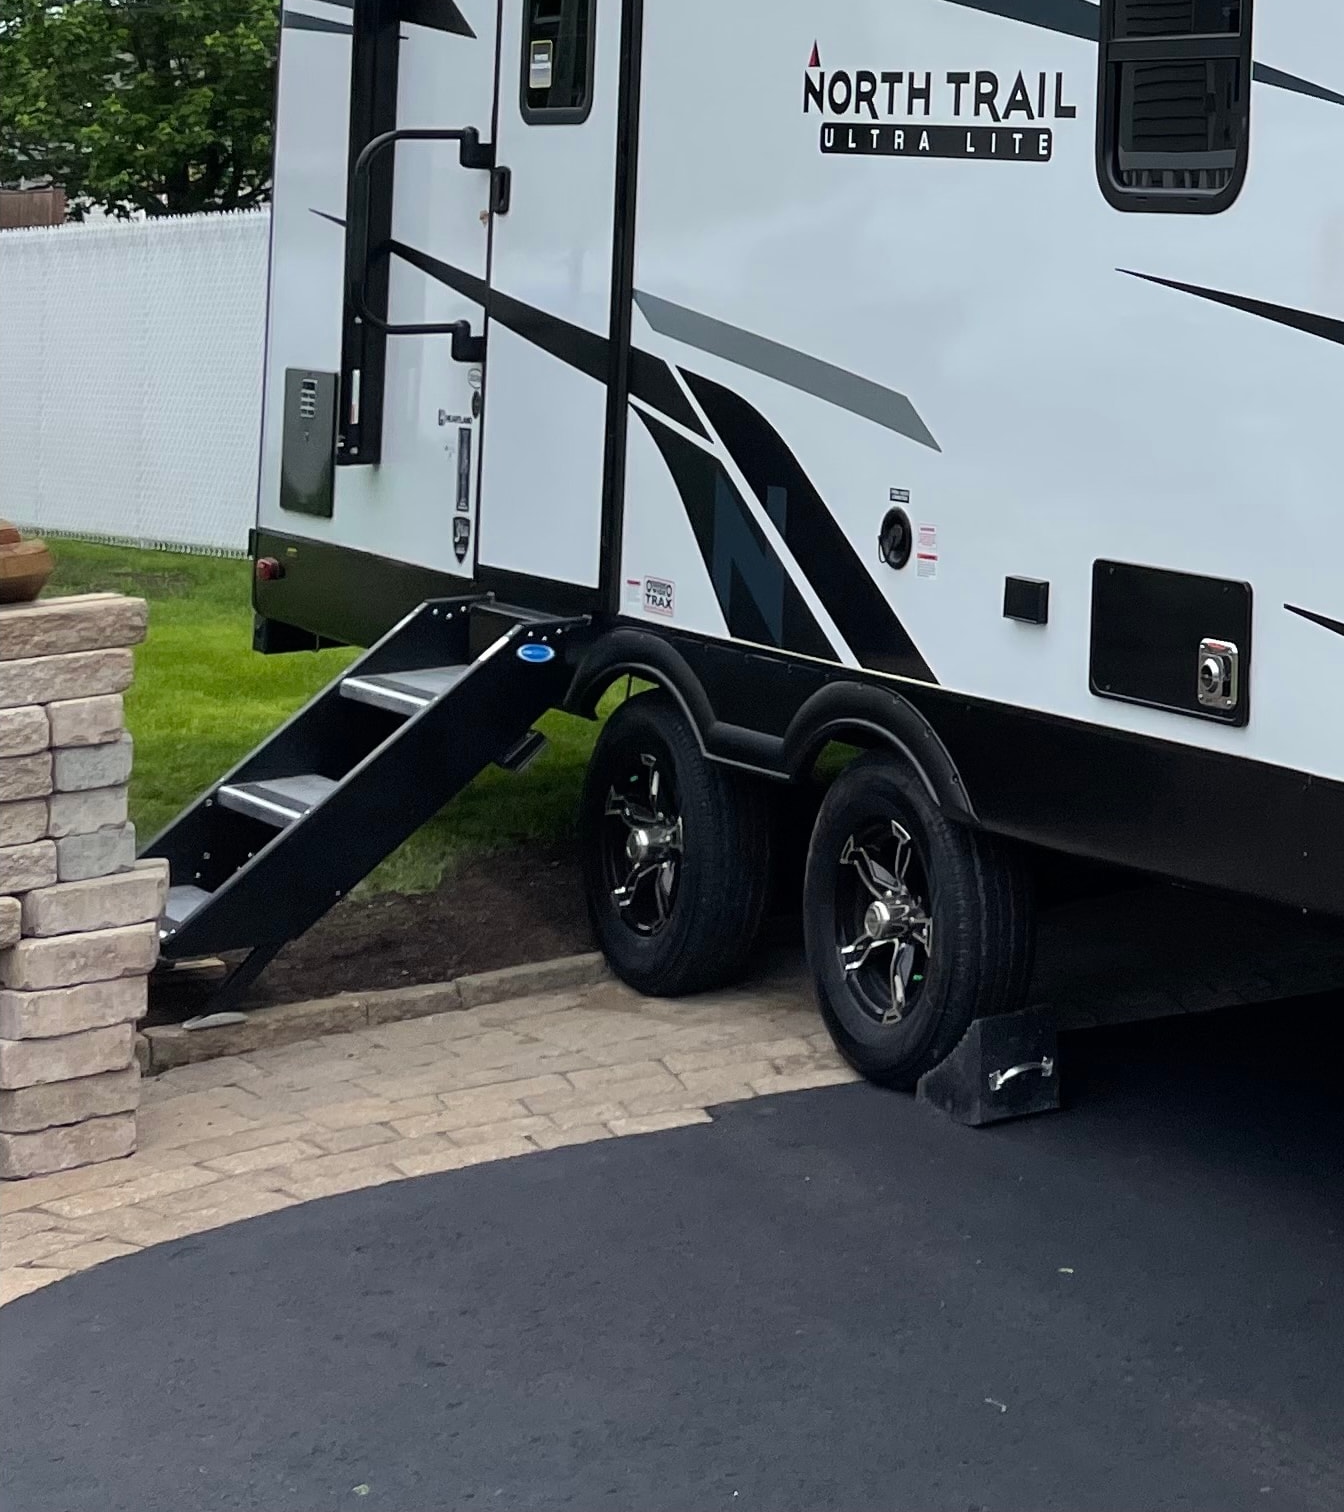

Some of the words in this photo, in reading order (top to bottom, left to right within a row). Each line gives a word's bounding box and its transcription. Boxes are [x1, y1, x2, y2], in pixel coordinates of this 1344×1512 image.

[803, 69, 932, 120] NORTH
[946, 69, 1077, 122] TRAIL
[824, 127, 930, 152] ULTRA
[966, 132, 1049, 156] LITE
[645, 593, 673, 610] TRAX
